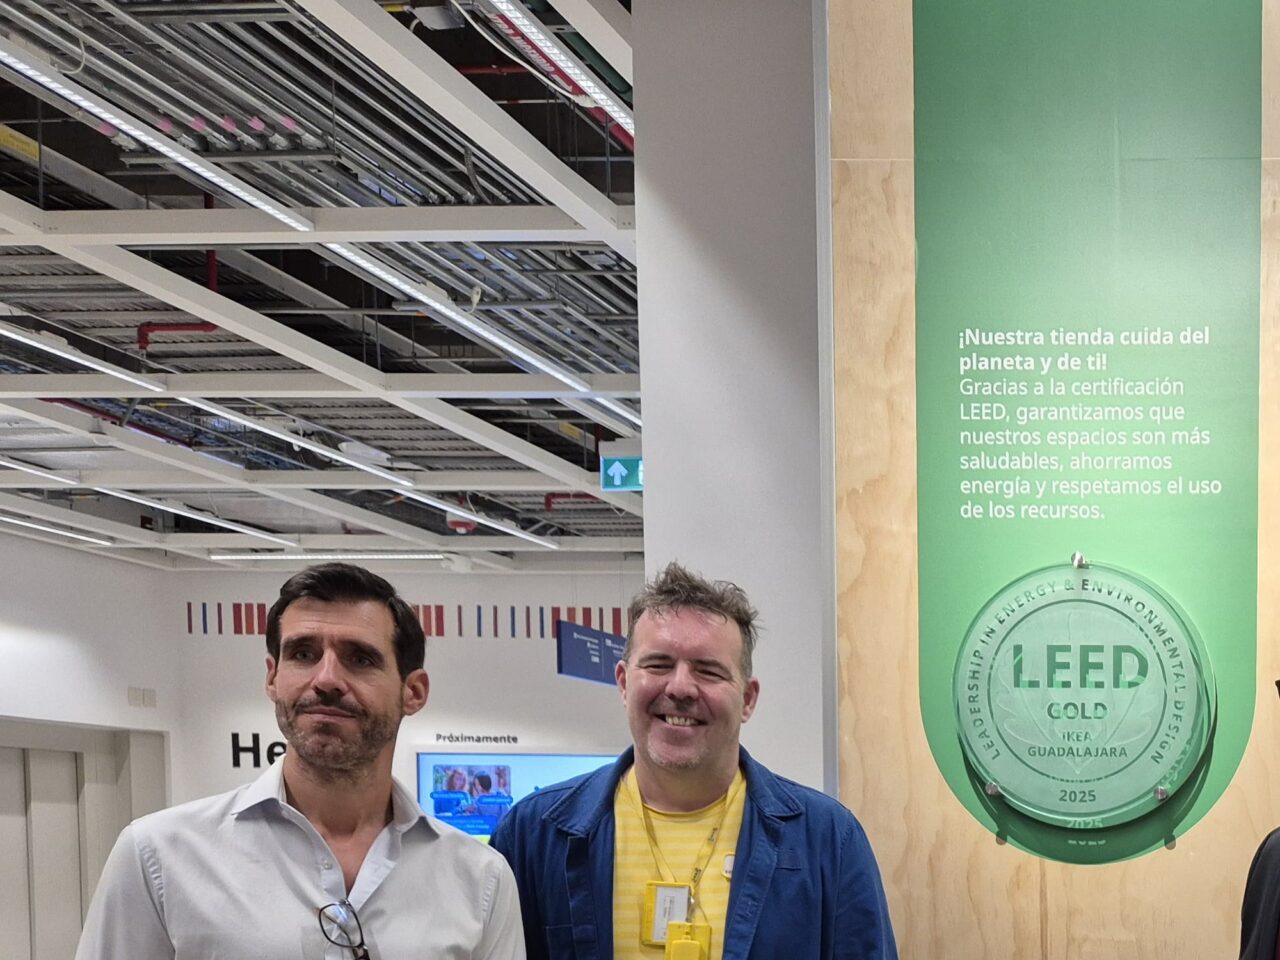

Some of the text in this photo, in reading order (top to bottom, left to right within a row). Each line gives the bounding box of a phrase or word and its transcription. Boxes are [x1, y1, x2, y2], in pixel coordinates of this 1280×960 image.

[959, 326, 1209, 349] ¡Nuestra tienda cuida del
[960, 353, 1106, 375] planeta y de ti!
[960, 377, 1183, 396] Gracias a la certificación
[960, 403, 1184, 425] LEED, garantizamos que
[960, 427, 1210, 449] nuestros espacios son más
[960, 451, 1172, 472] saludables, ahorramos
[960, 476, 1222, 499] energía y respetamos el uso
[960, 500, 1104, 519] de los recursos.
[968, 578, 1187, 765] LEADERSHIP IN ENERGY & ENVIRONMENTAL DESIGN
[1013, 644, 1149, 689] LEED
[1047, 702, 1108, 720] GOLD
[436, 733, 518, 744] Próximamente
[1062, 731, 1093, 742] IKEA
[231, 733, 286, 768] He
[1028, 746, 1128, 758] GUADALAJARA
[1059, 789, 1096, 802] 2025
